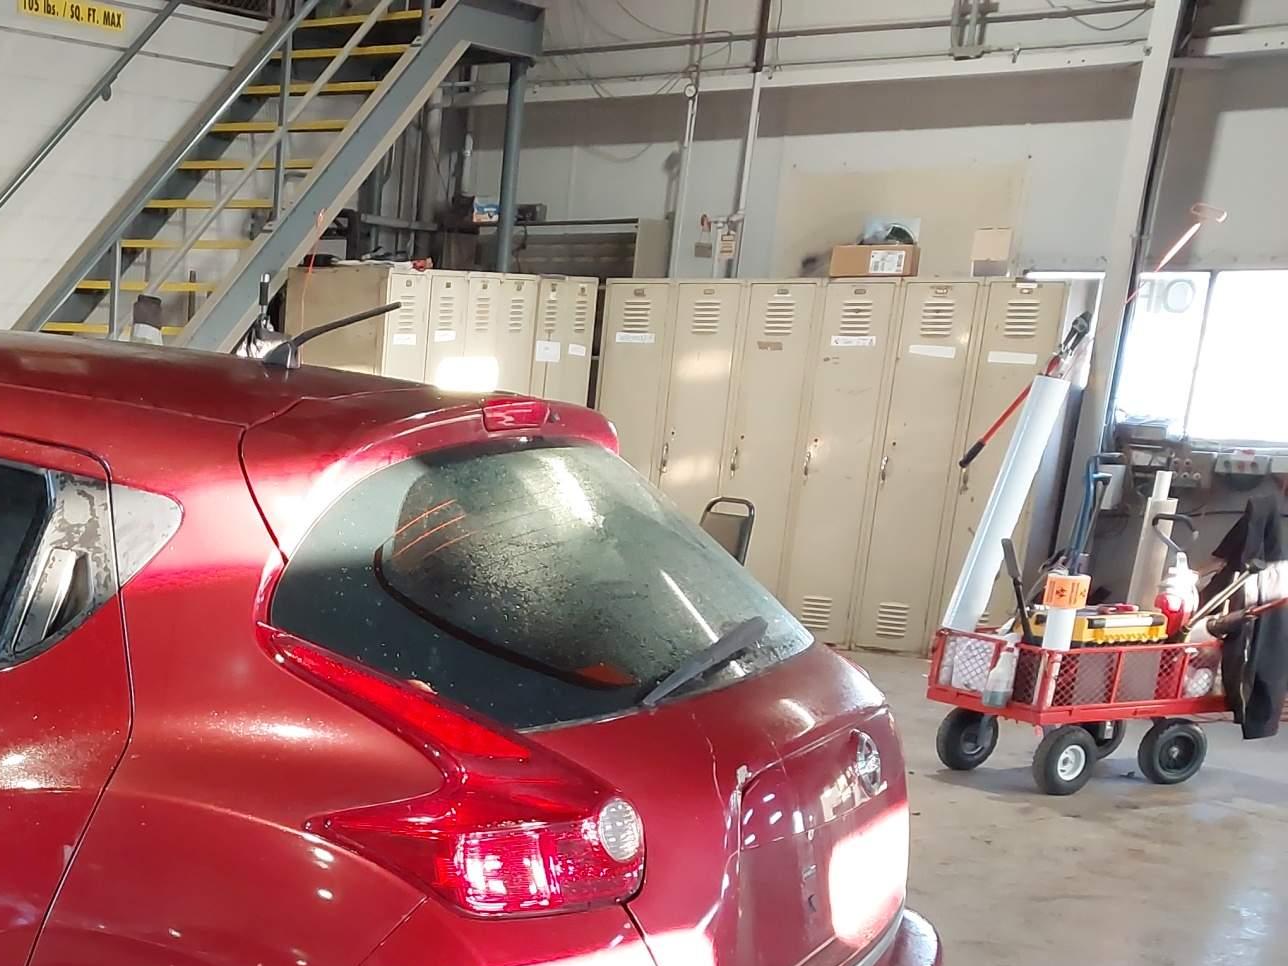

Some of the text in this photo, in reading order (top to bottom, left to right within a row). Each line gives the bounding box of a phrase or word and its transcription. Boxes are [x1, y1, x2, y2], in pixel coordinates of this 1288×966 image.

[43, 0, 59, 17] lbs.
[62, 1, 67, 17] /
[70, 4, 84, 21] SQ.
[87, 8, 99, 24] FT.
[103, 11, 122, 28] MAX
